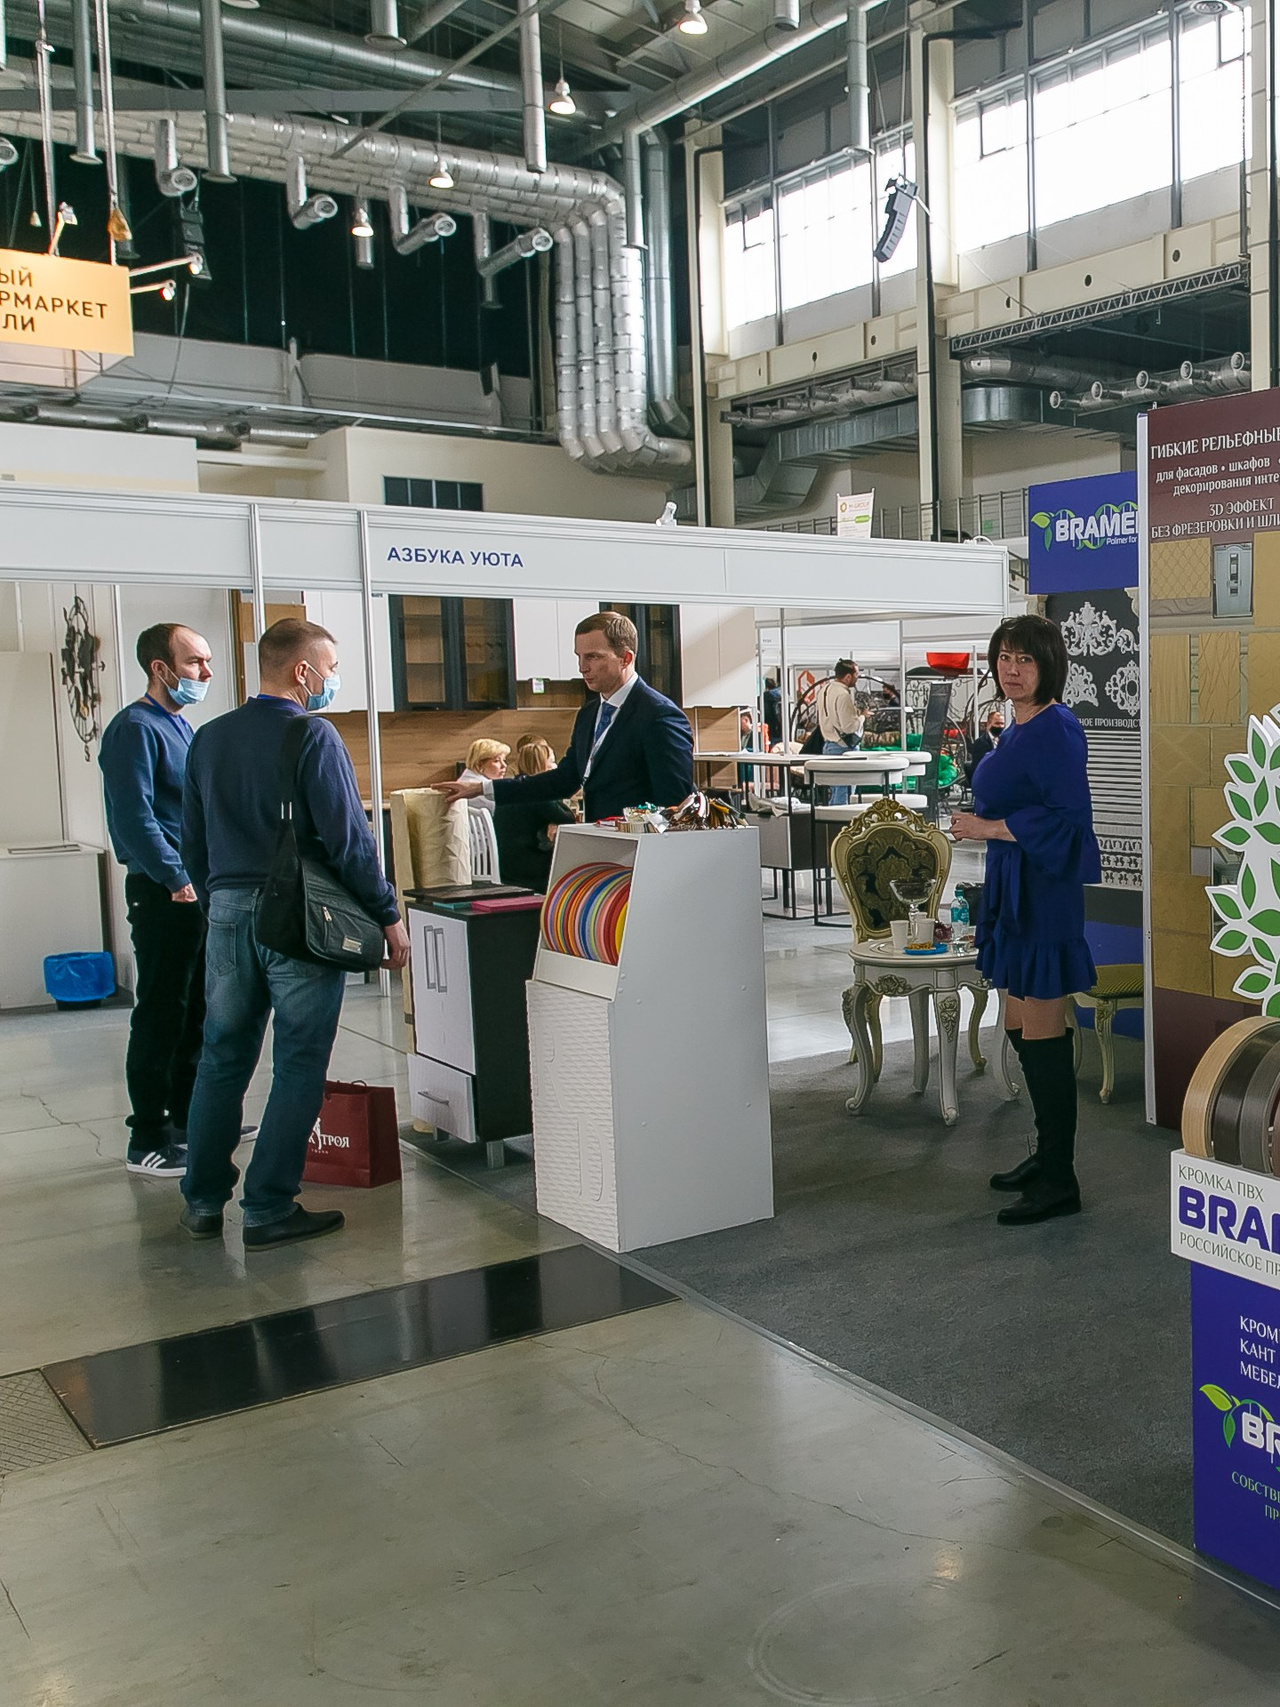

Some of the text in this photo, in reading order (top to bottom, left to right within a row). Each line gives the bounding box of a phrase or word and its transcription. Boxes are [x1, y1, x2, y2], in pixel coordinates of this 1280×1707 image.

[2, 313, 35, 332] ЛИ
[1151, 439, 1198, 460] ГИБКИЕ
[1156, 470, 1174, 484] для
[1176, 464, 1218, 481] фасадов
[1229, 456, 1270, 472] шкафов
[1173, 476, 1250, 497] декорирования
[1209, 498, 1274, 516] 3D ЭФФЕКТ
[1152, 526, 1170, 538] БЕЗ
[1172, 515, 1246, 536] ФРЕЗЕРОВКИ
[1246, 516, 1254, 528] И
[1106, 536, 1138, 545] Polimer for
[387, 547, 524, 568] АЗБУКА УЮТА
[1178, 1164, 1264, 1202] КРОМКА ПВХ
[1180, 1232, 1262, 1271] РОССИЙСКОЕ
[1240, 1338, 1276, 1364] КАНТ
